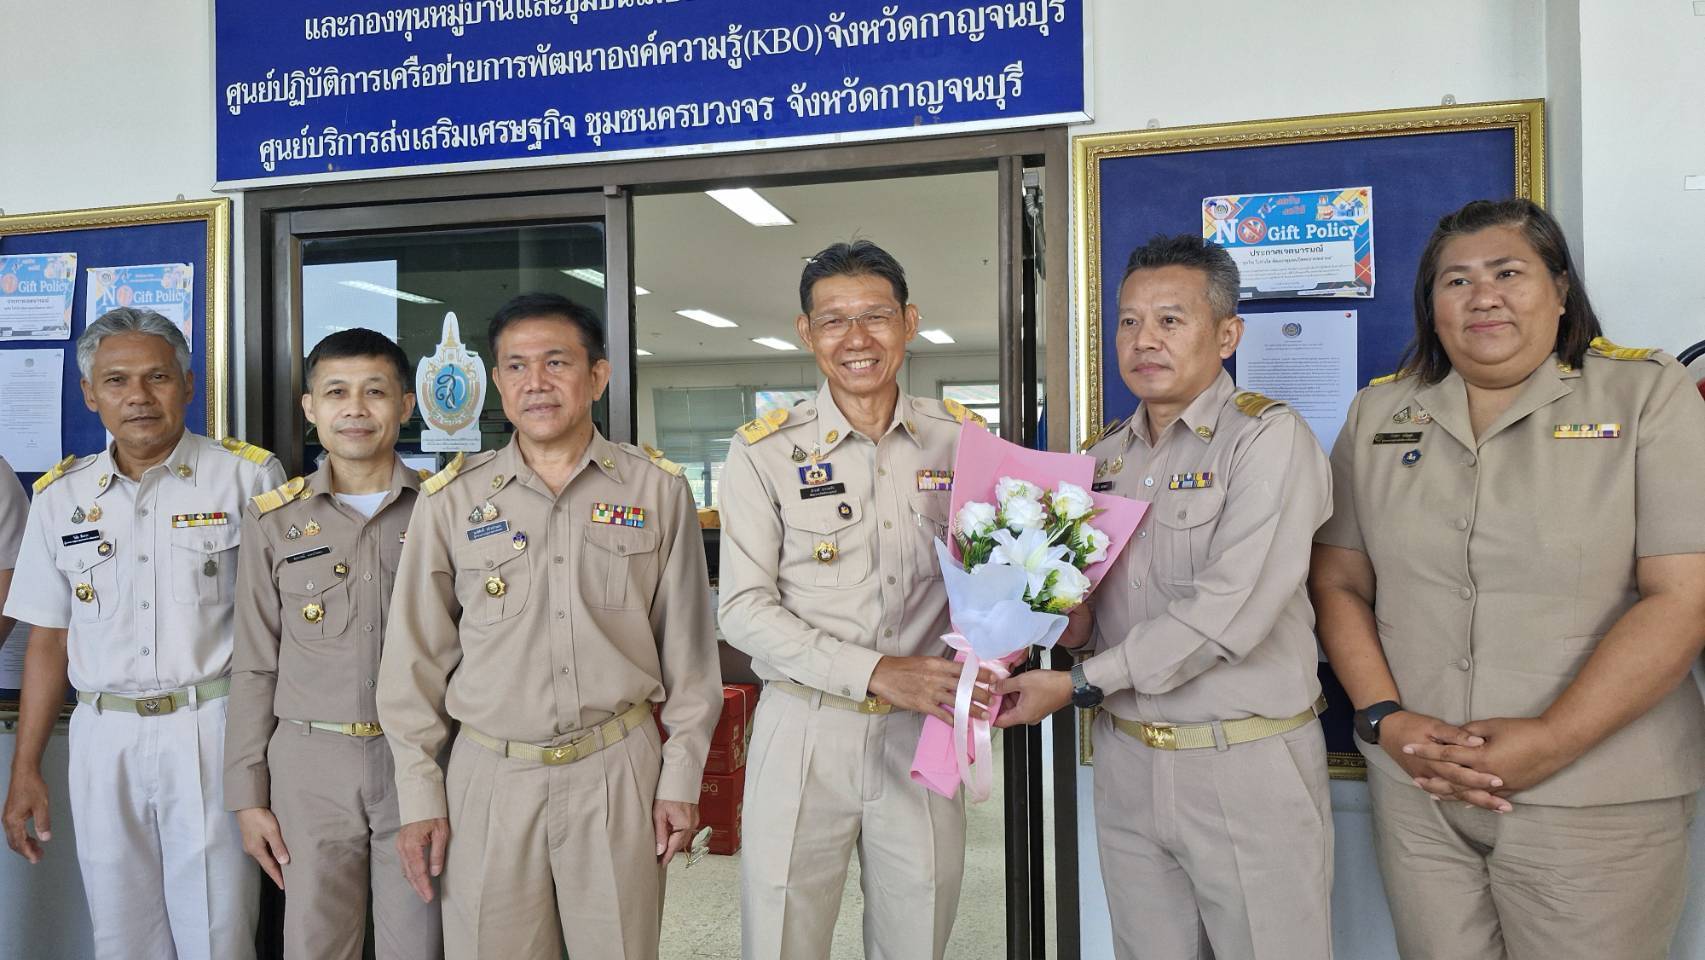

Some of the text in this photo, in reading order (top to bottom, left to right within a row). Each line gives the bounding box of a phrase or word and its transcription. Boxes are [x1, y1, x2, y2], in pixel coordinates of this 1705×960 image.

[225, 0, 1067, 115] ศูนย์ปฏิบัติการเครือข่ายการพัฒนาองค์ความรู้(KBO)จังหวัดกาญจนบุร
[258, 60, 1025, 172] ศูนย์บริการส่งเสริมเศรษฐกิจ ชุมชนครบวงจร จังหวัดกาญจนบุรี
[1267, 224, 1300, 242] Gift
[1306, 222, 1360, 241] Policy
[18, 281, 39, 293] Gift
[40, 280, 69, 295] Policy
[134, 290, 153, 304] Gift
[156, 289, 187, 304] Policy
